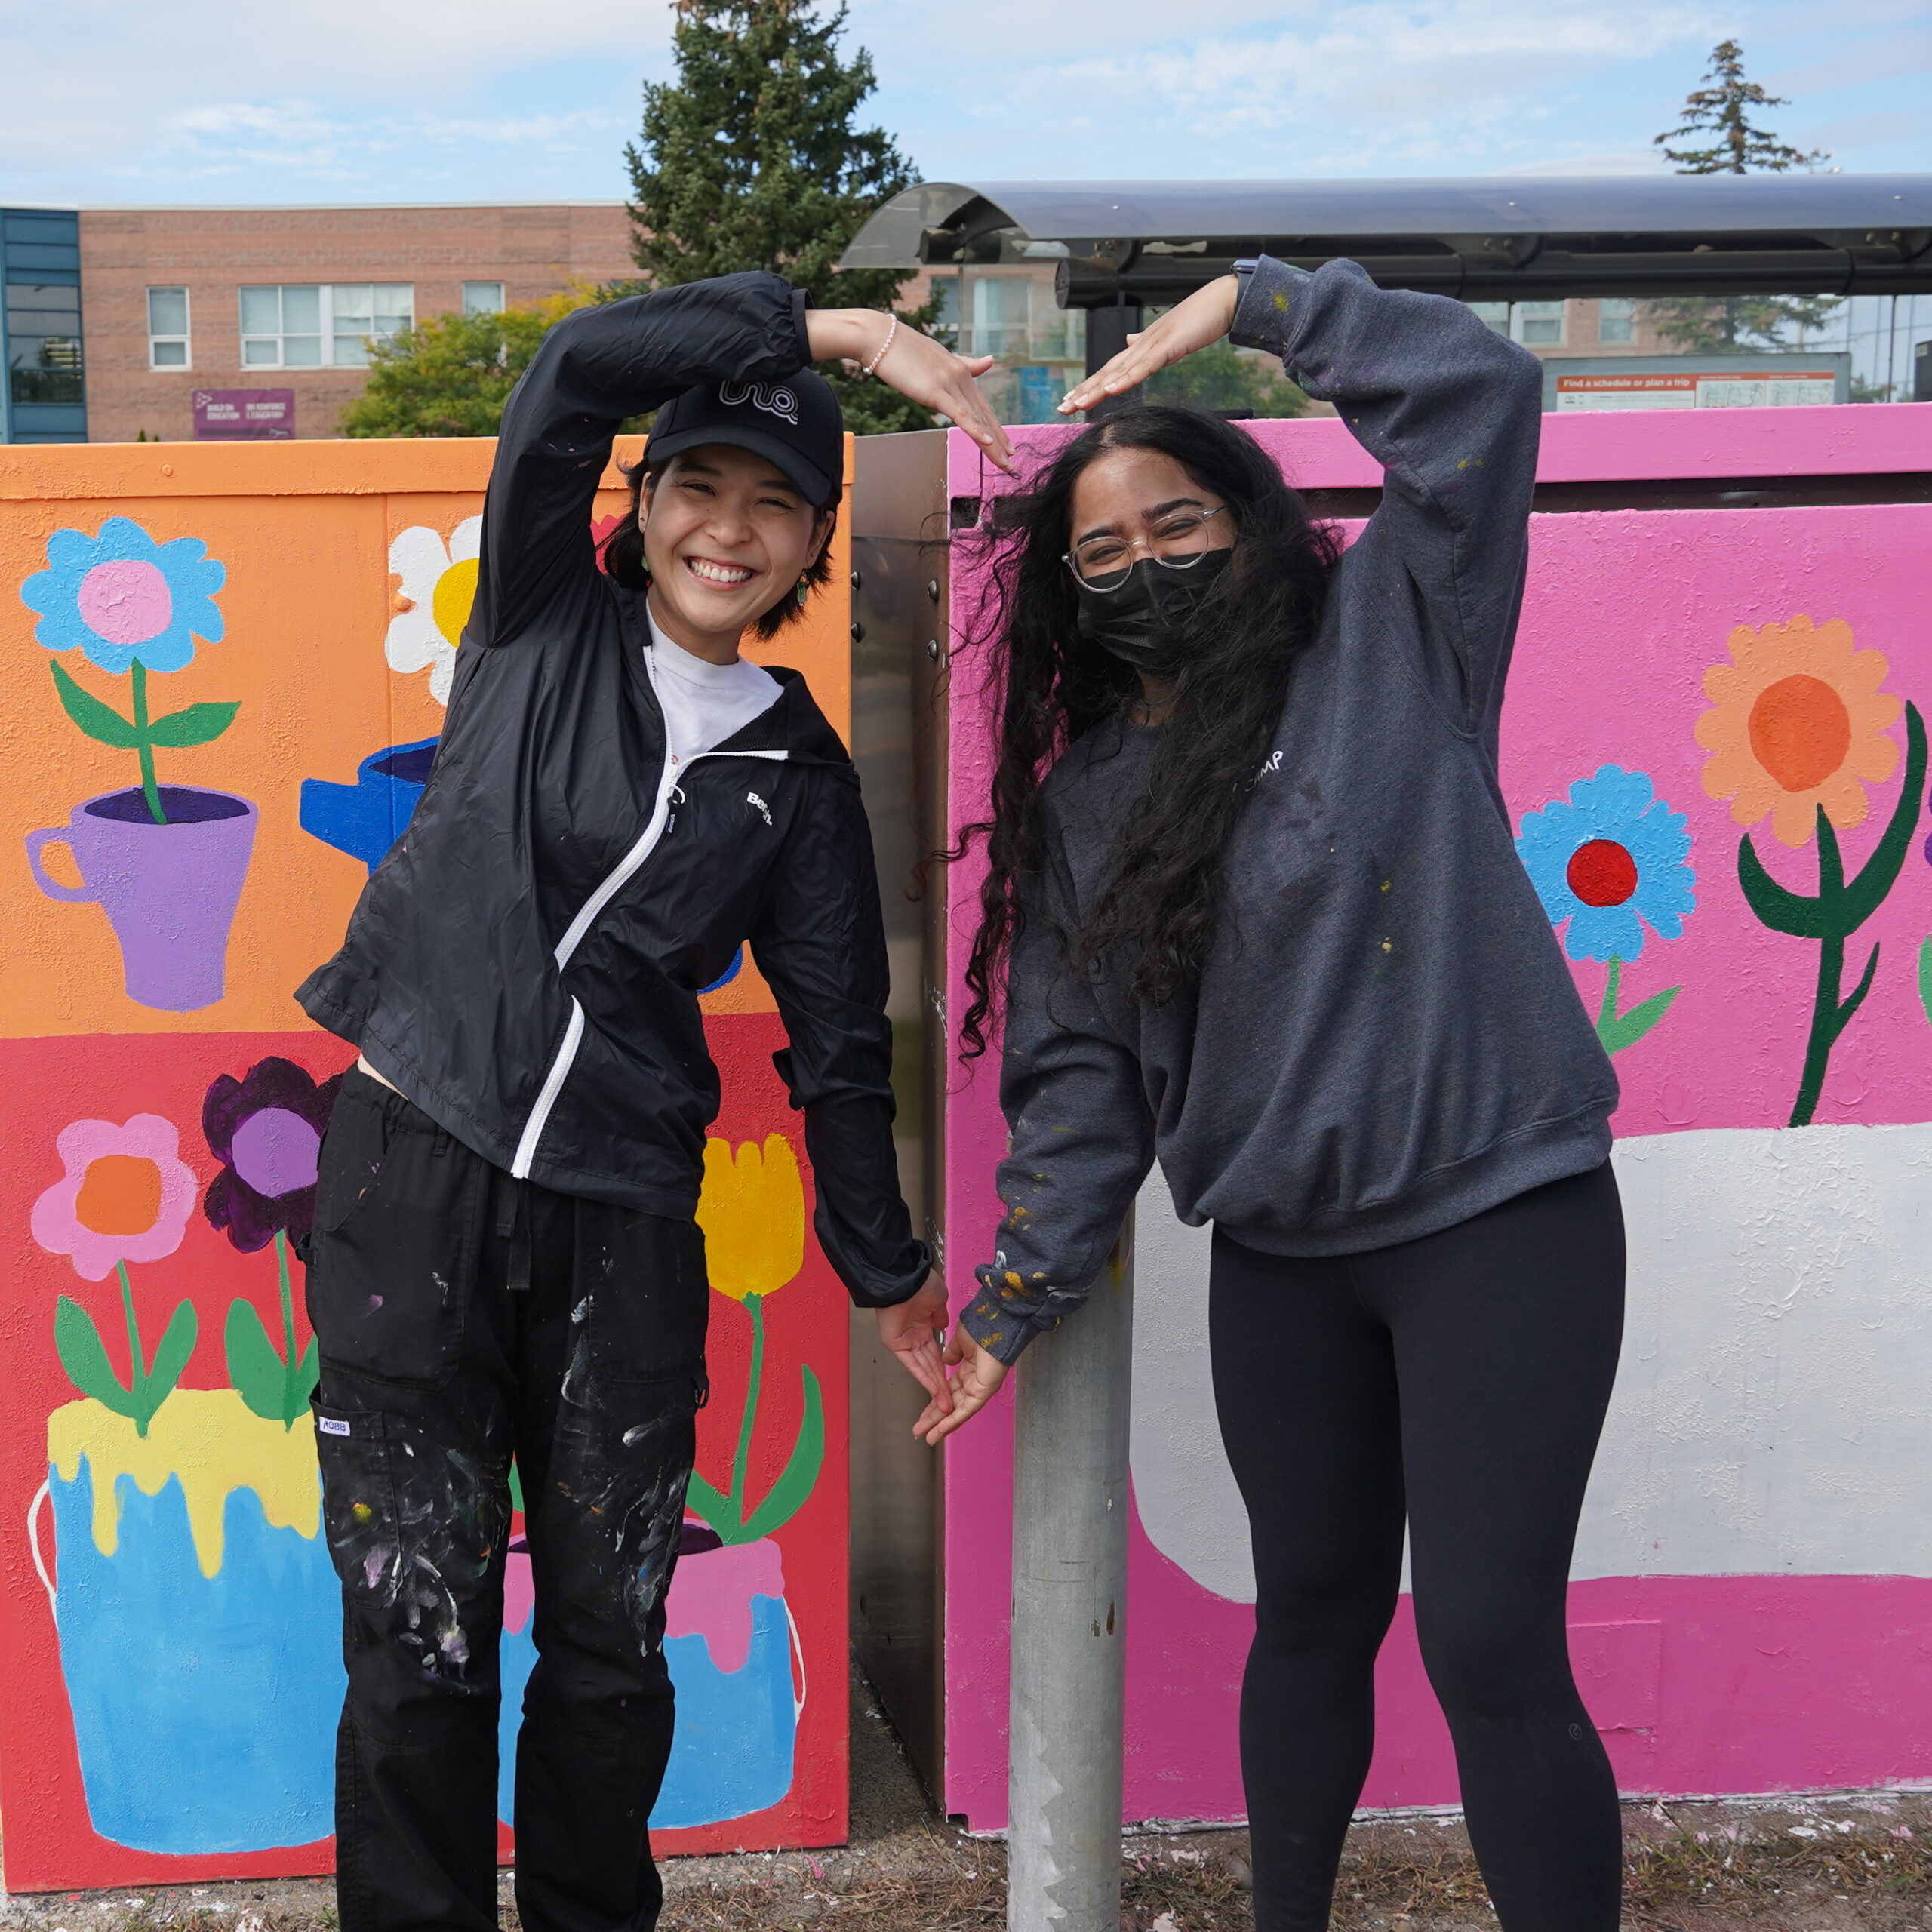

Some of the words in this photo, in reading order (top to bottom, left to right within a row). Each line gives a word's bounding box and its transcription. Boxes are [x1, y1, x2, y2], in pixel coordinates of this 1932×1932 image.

[1564, 379, 1583, 388] Find
[1593, 378, 1632, 388] schedule
[1645, 378, 1665, 389] plan
[1674, 378, 1690, 389] trip
